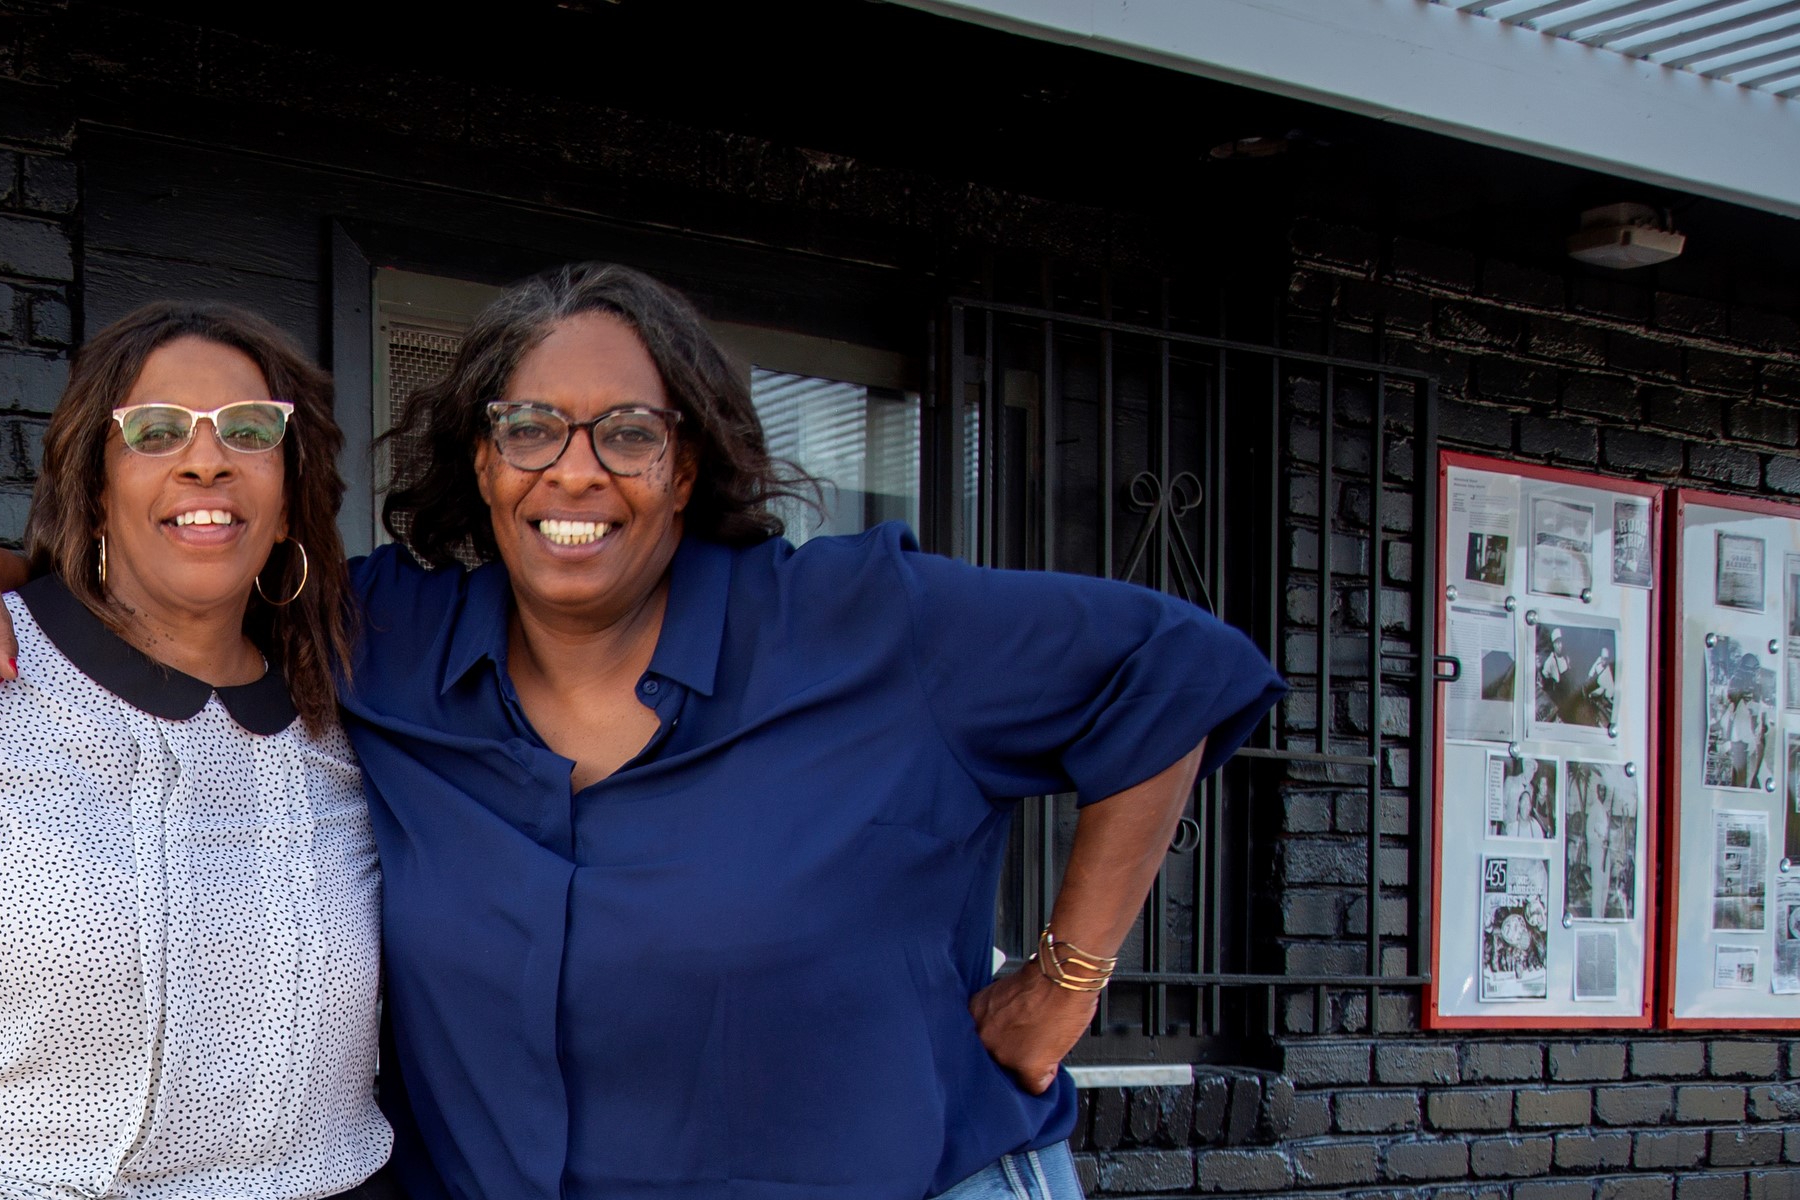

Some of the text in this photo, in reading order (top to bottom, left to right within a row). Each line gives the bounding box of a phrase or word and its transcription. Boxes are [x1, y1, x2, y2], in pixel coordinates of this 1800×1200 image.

[1619, 519, 1648, 537] ROAD
[1485, 860, 1507, 886] 435
[1500, 894, 1525, 908] BEST
